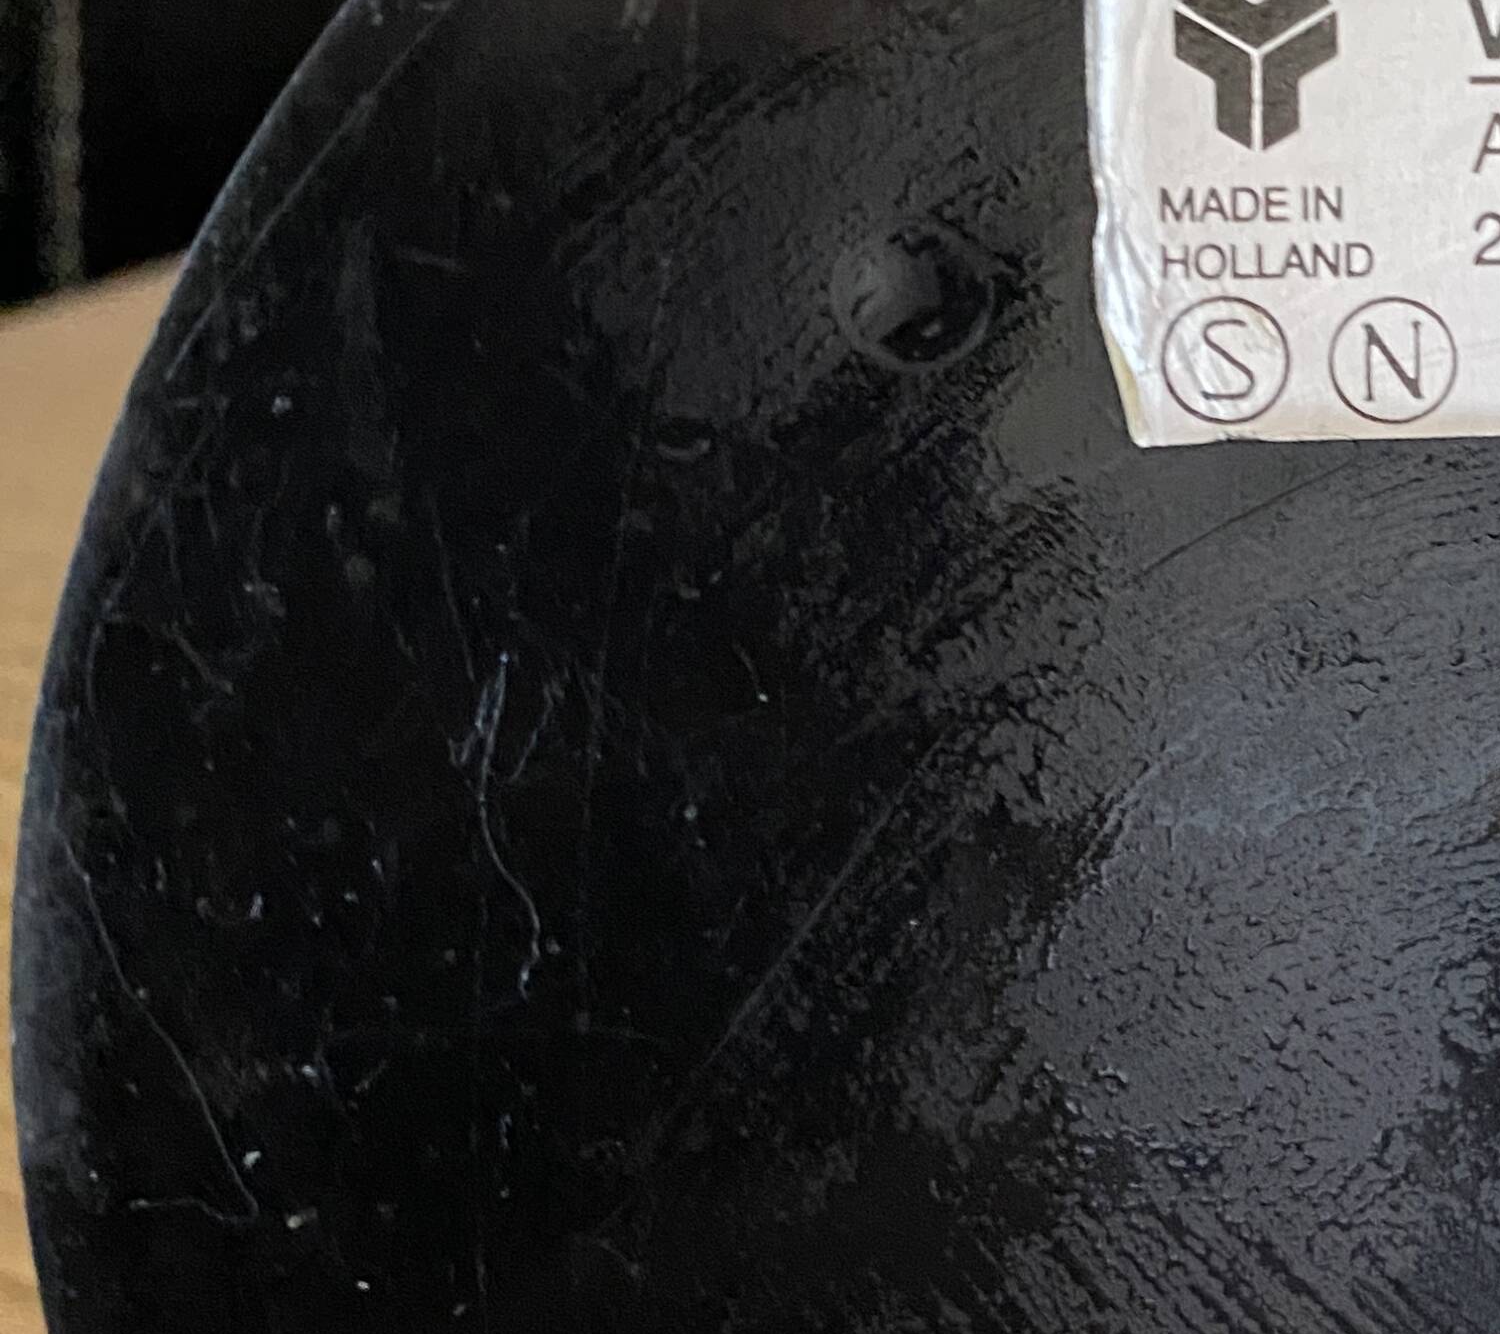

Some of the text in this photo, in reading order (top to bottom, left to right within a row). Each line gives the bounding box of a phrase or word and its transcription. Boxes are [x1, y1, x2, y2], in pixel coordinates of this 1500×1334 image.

[1159, 185, 1344, 223] MADE IN
[1160, 241, 1375, 281] HOLLAND
